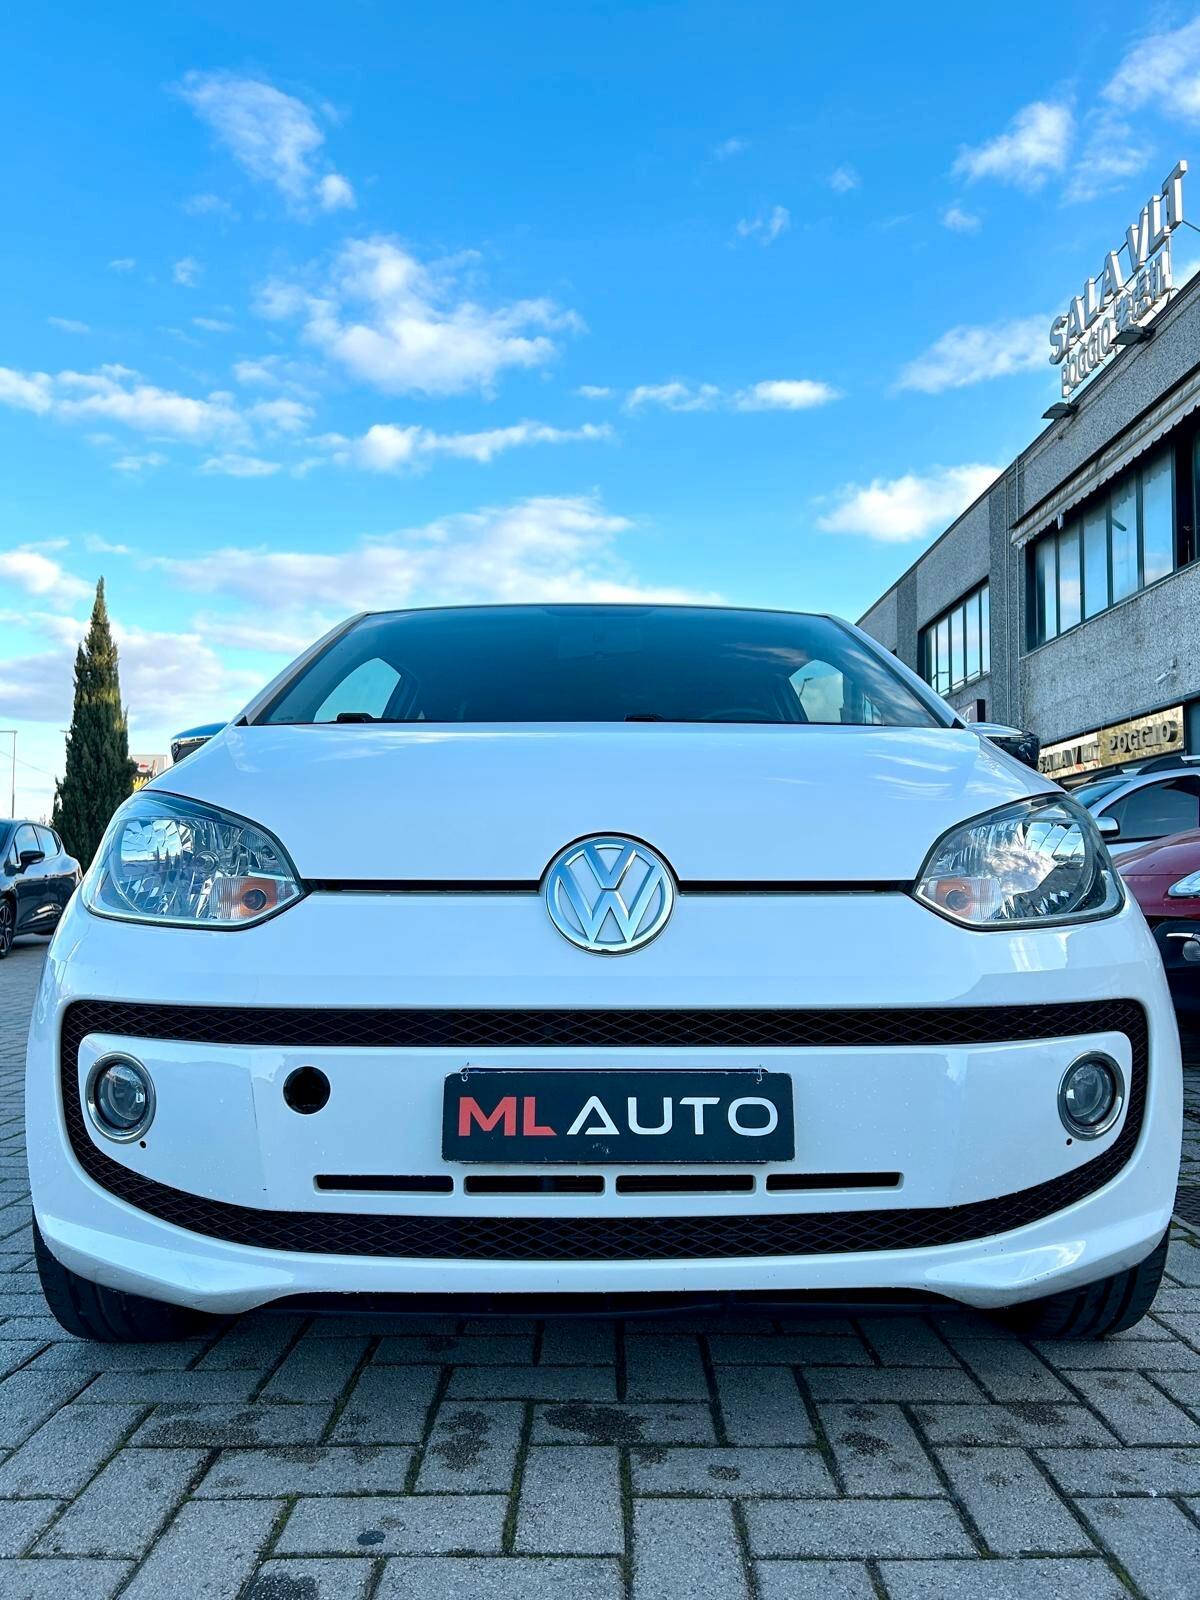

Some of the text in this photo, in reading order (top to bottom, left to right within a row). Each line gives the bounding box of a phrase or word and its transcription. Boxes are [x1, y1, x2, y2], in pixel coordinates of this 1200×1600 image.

[1049, 160, 1188, 365] SALA VLT
[1061, 316, 1113, 398] POGGIO
[1038, 749, 1072, 773] SALA
[1109, 720, 1177, 755] POGGIO
[458, 1095, 779, 1137] ML AUTO
